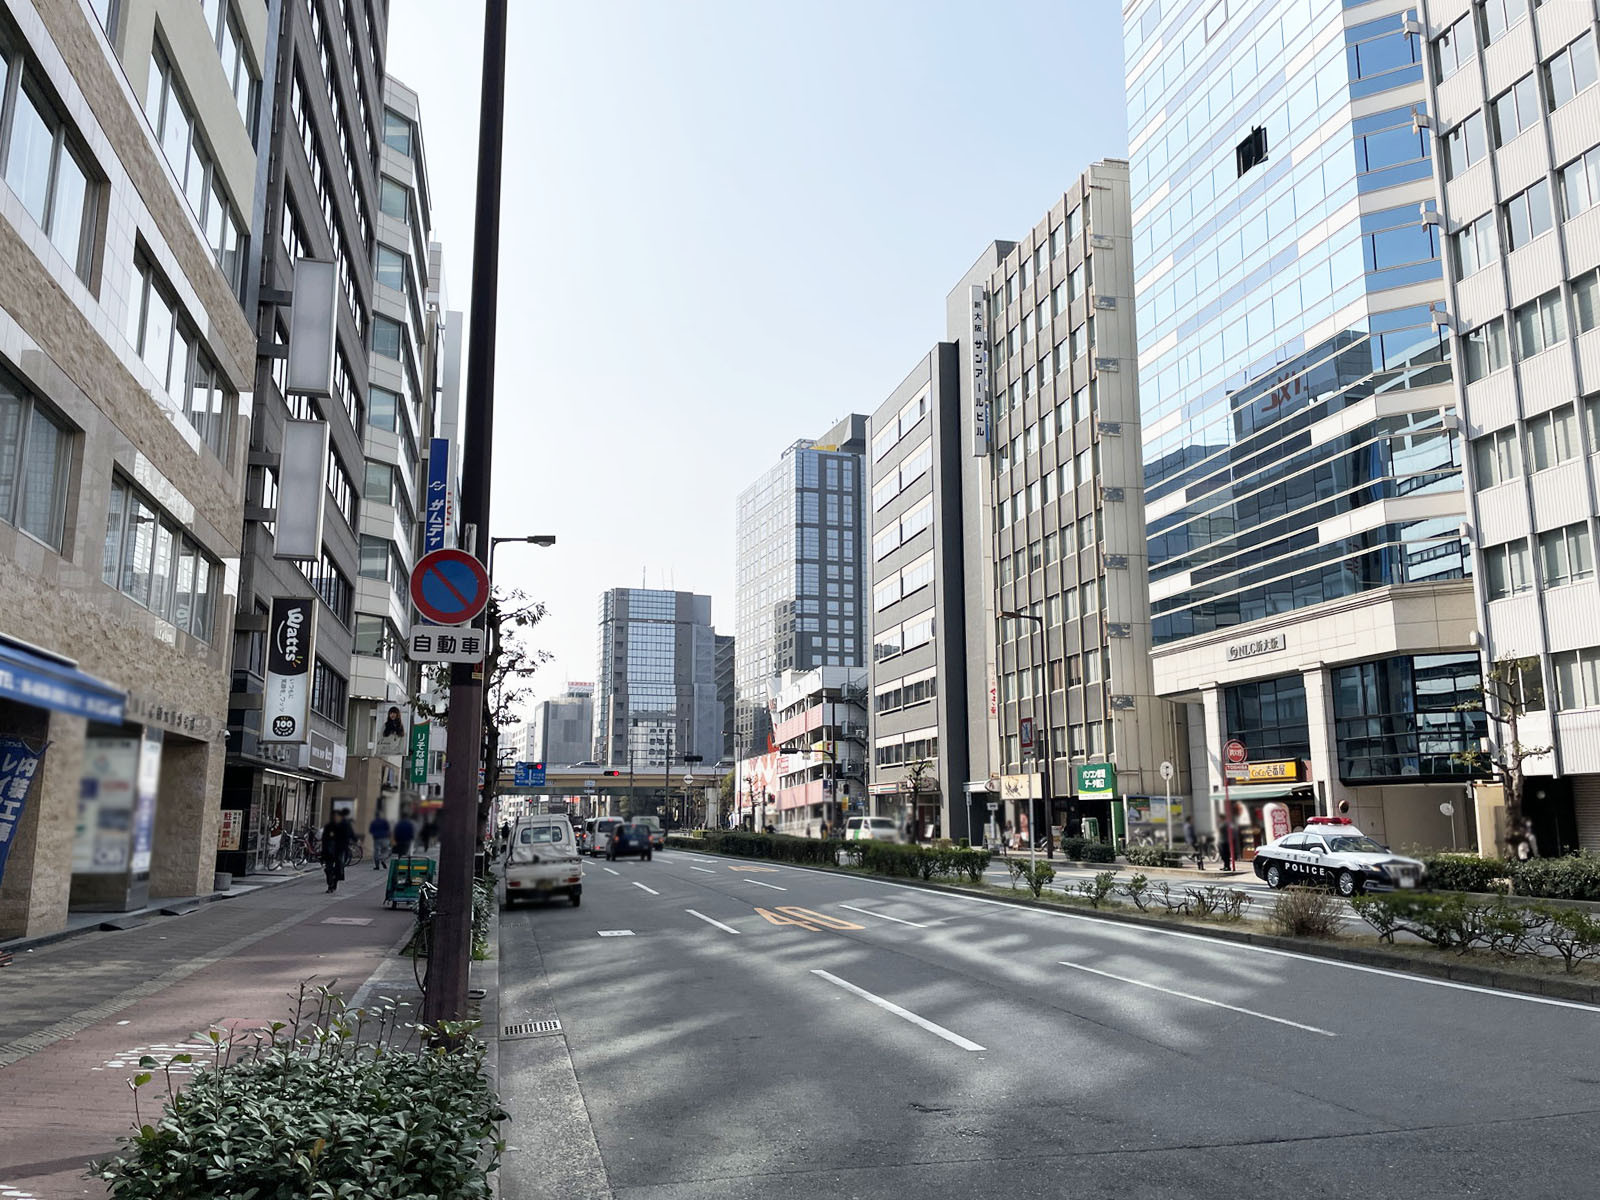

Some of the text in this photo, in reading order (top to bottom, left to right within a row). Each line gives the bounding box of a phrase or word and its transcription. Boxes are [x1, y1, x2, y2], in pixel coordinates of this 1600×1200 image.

[427, 499, 444, 553] サムティ
[285, 607, 304, 661] Watts
[413, 634, 480, 655] 自動車
[275, 720, 293, 728] 100
[415, 732, 426, 776] りそな銀行
[1284, 862, 1325, 876] POLICE
[753, 906, 866, 932] 40
